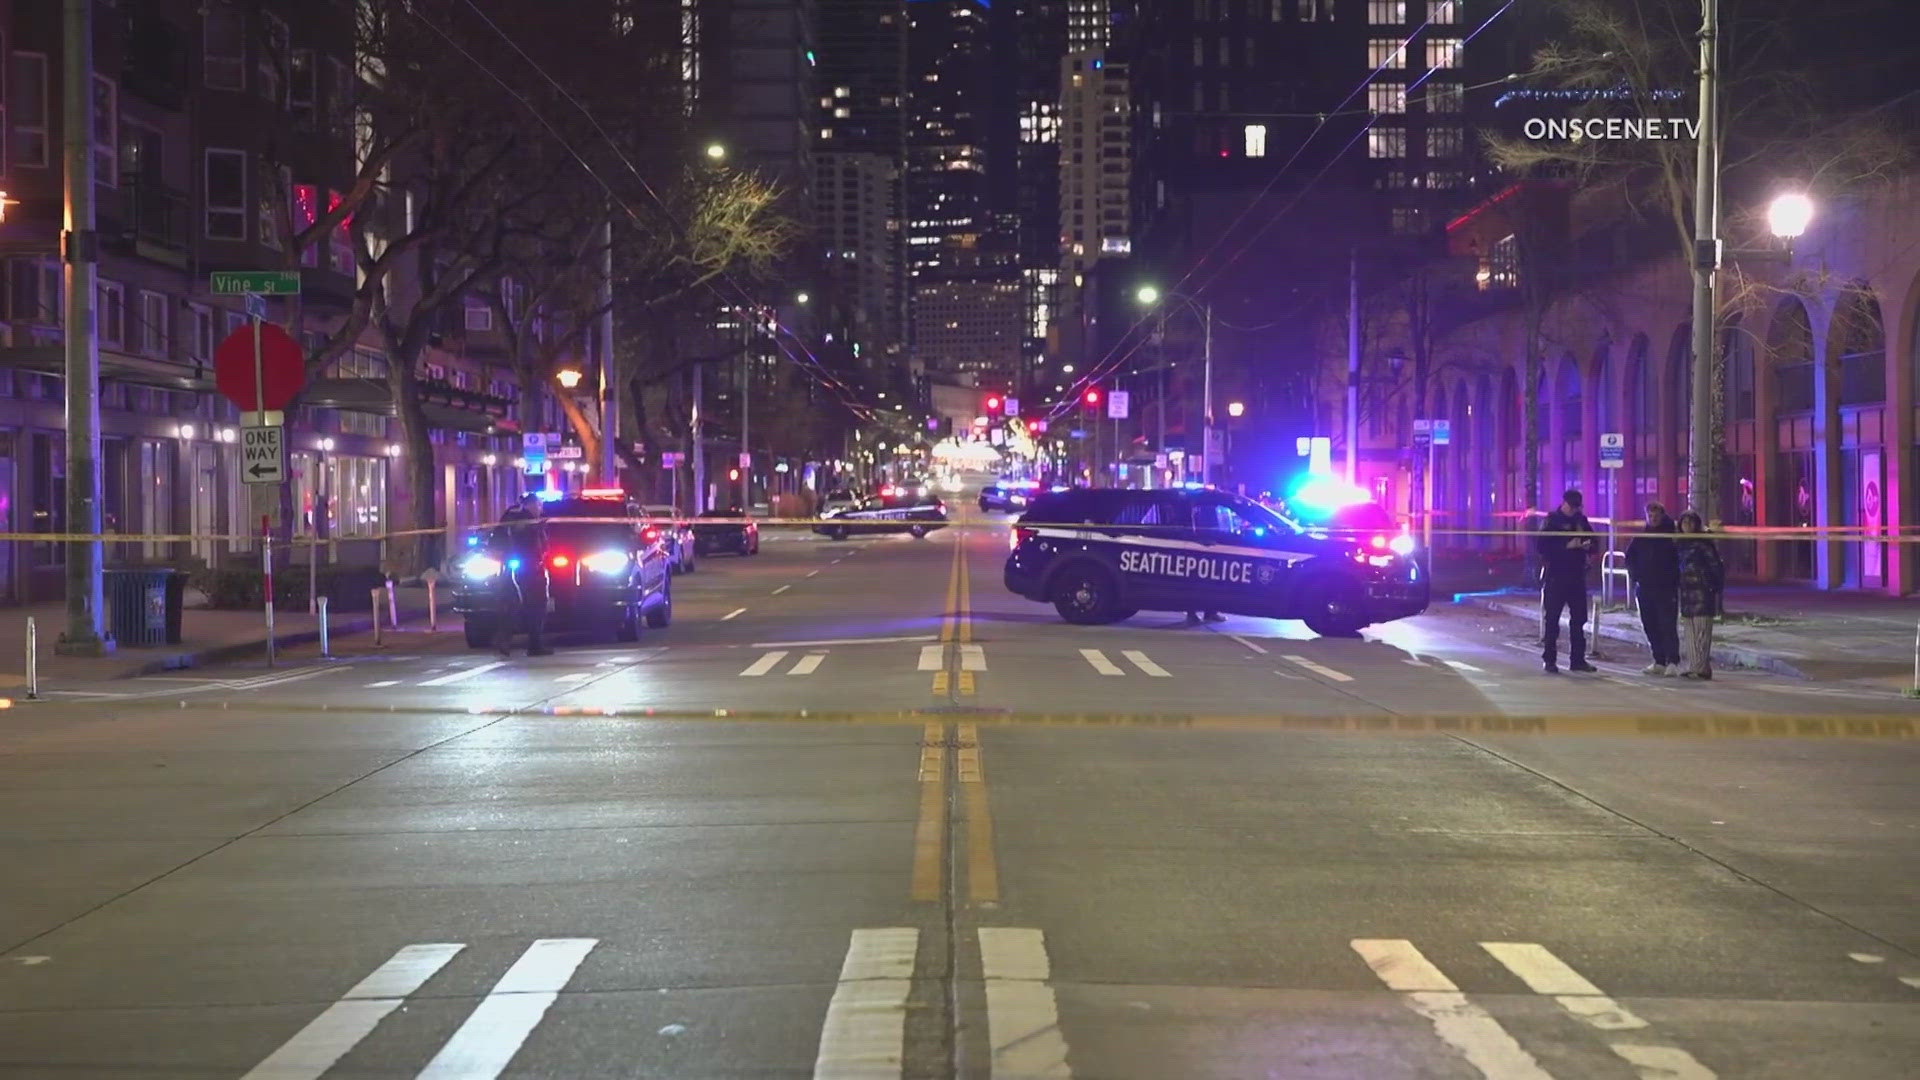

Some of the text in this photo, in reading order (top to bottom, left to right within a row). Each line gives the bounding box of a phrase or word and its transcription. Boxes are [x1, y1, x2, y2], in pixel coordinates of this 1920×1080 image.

[216, 276, 251, 292] Vine
[245, 431, 276, 445] ONE
[245, 447, 277, 460] WAY
